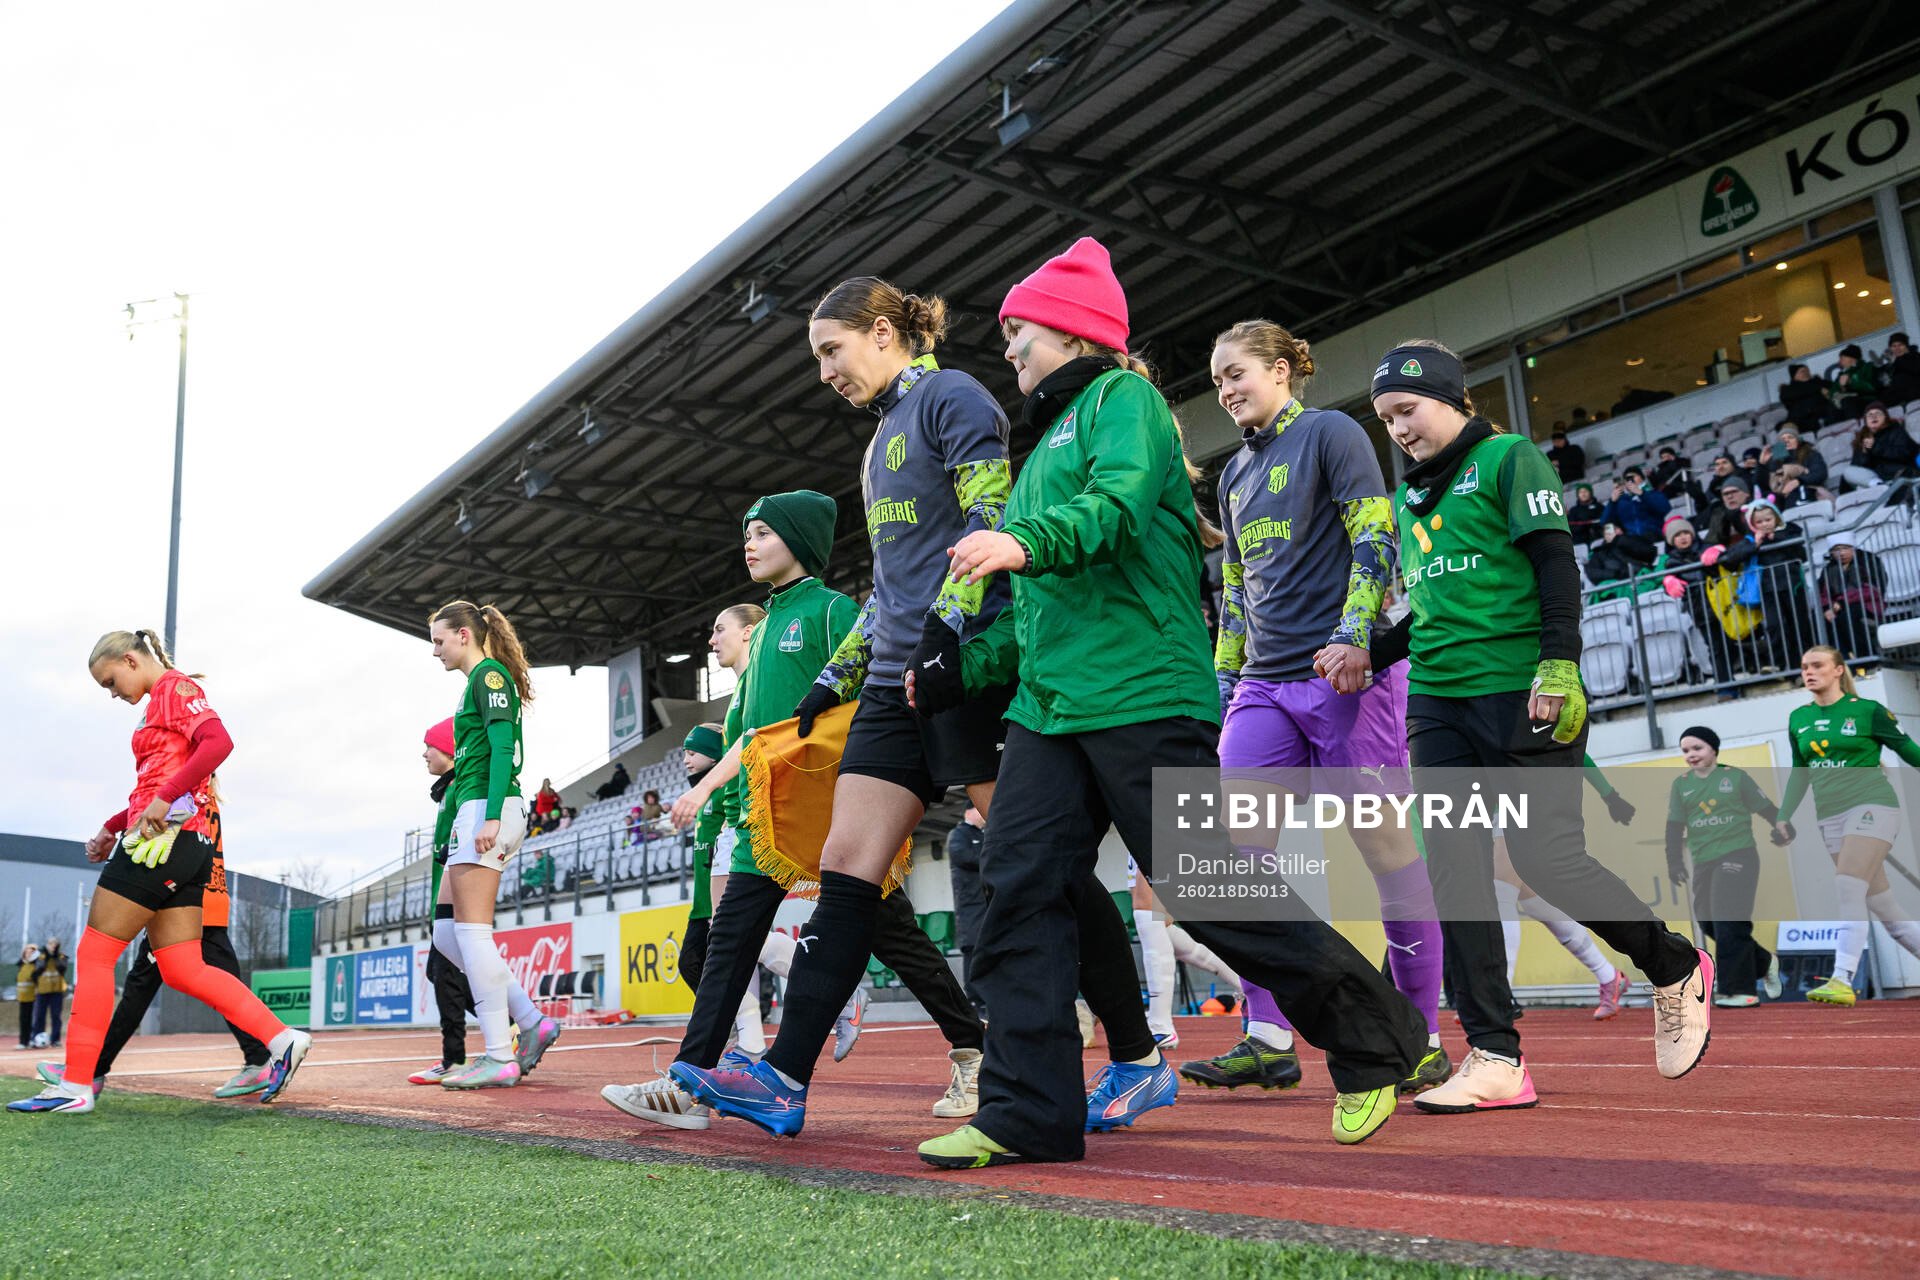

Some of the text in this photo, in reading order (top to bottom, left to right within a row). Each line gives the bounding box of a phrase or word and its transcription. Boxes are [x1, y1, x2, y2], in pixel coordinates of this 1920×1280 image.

[1786, 96, 1920, 197] KÓ
[1526, 489, 1564, 517] Ifö
[488, 692, 509, 708] Ifö
[1802, 928, 1838, 940] Nilfi
[628, 931, 681, 984] KRÓ
